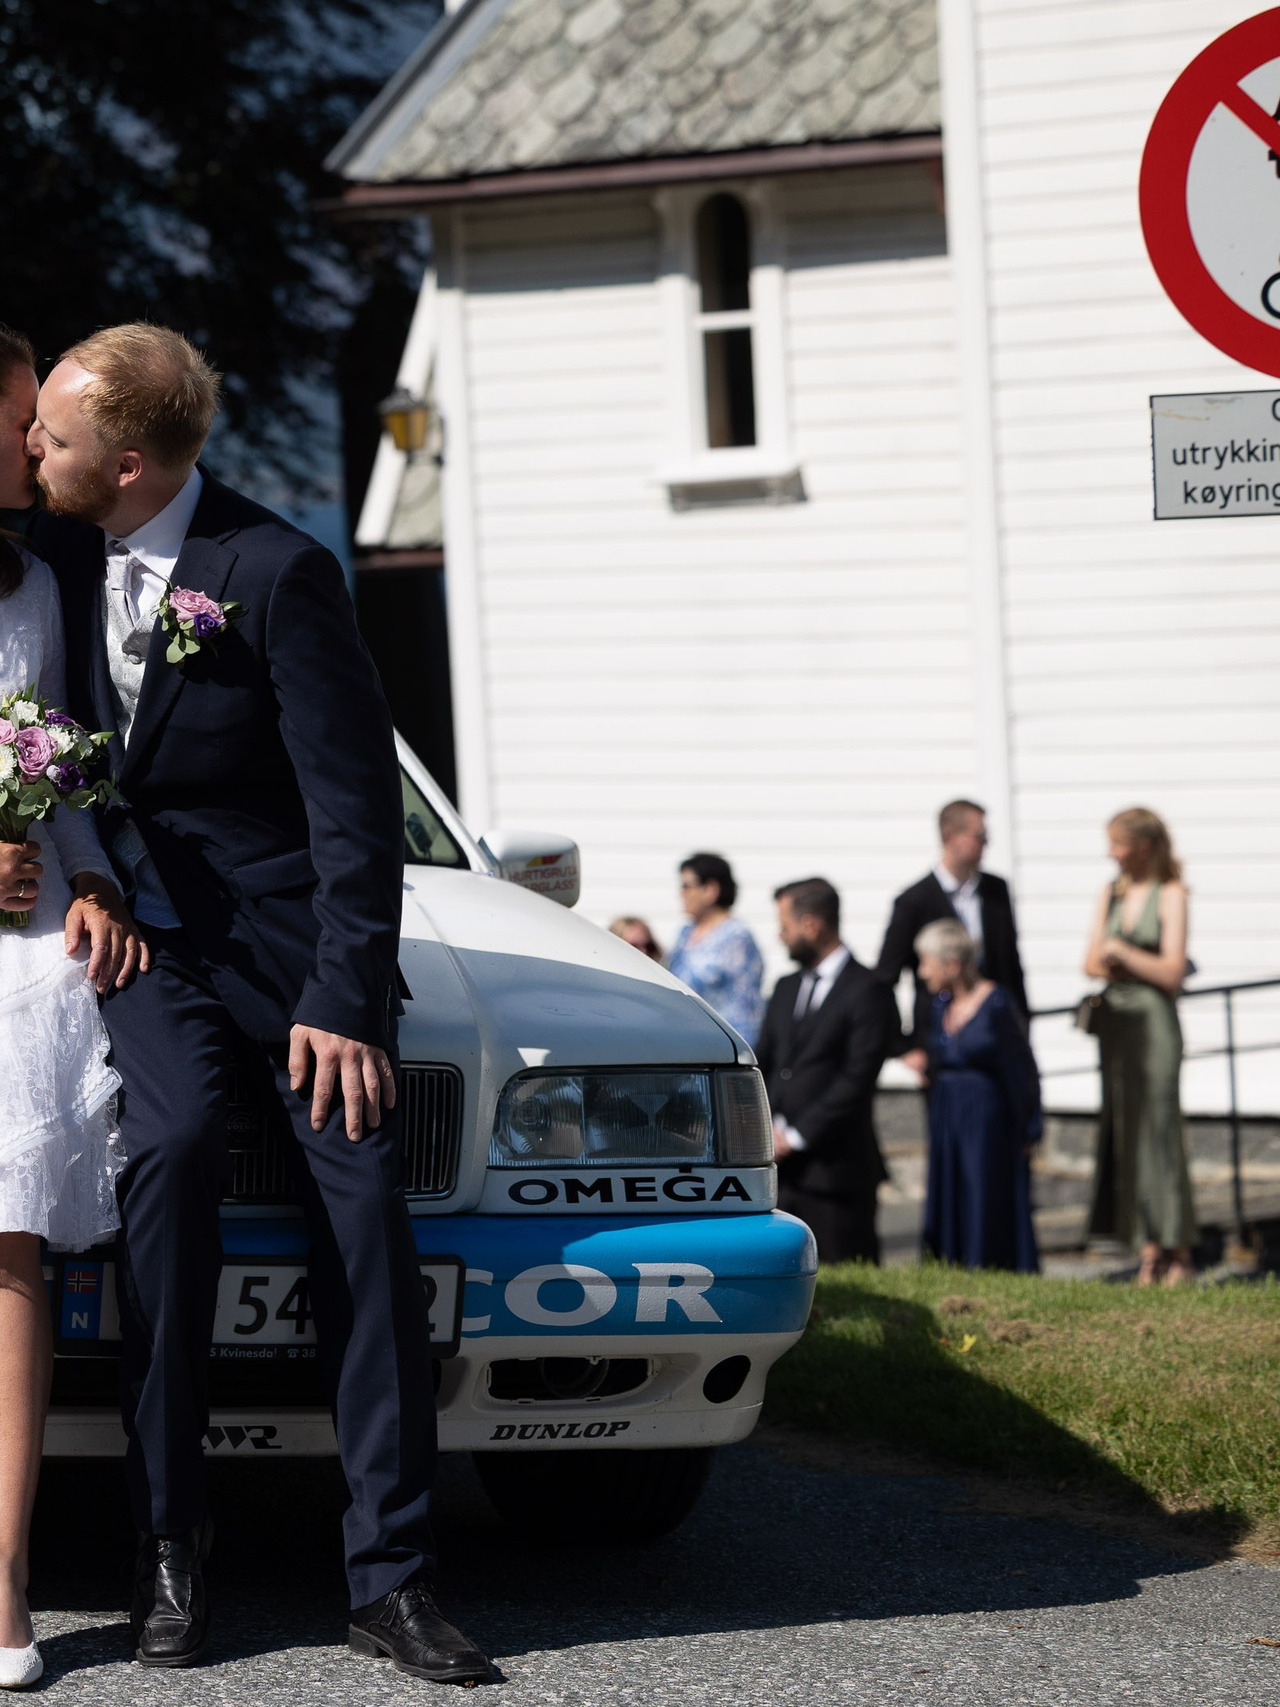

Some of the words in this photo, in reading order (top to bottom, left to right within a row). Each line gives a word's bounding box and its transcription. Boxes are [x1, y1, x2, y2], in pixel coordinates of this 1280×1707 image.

[1172, 438, 1280, 471] utrykkin
[508, 866, 578, 882] HURTIGRUTA
[524, 879, 575, 893] RGLASS
[507, 1174, 753, 1205] OMEGA
[70, 1311, 90, 1330] N
[201, 1426, 282, 1450] WR
[489, 1420, 631, 1441] DUNLOP
